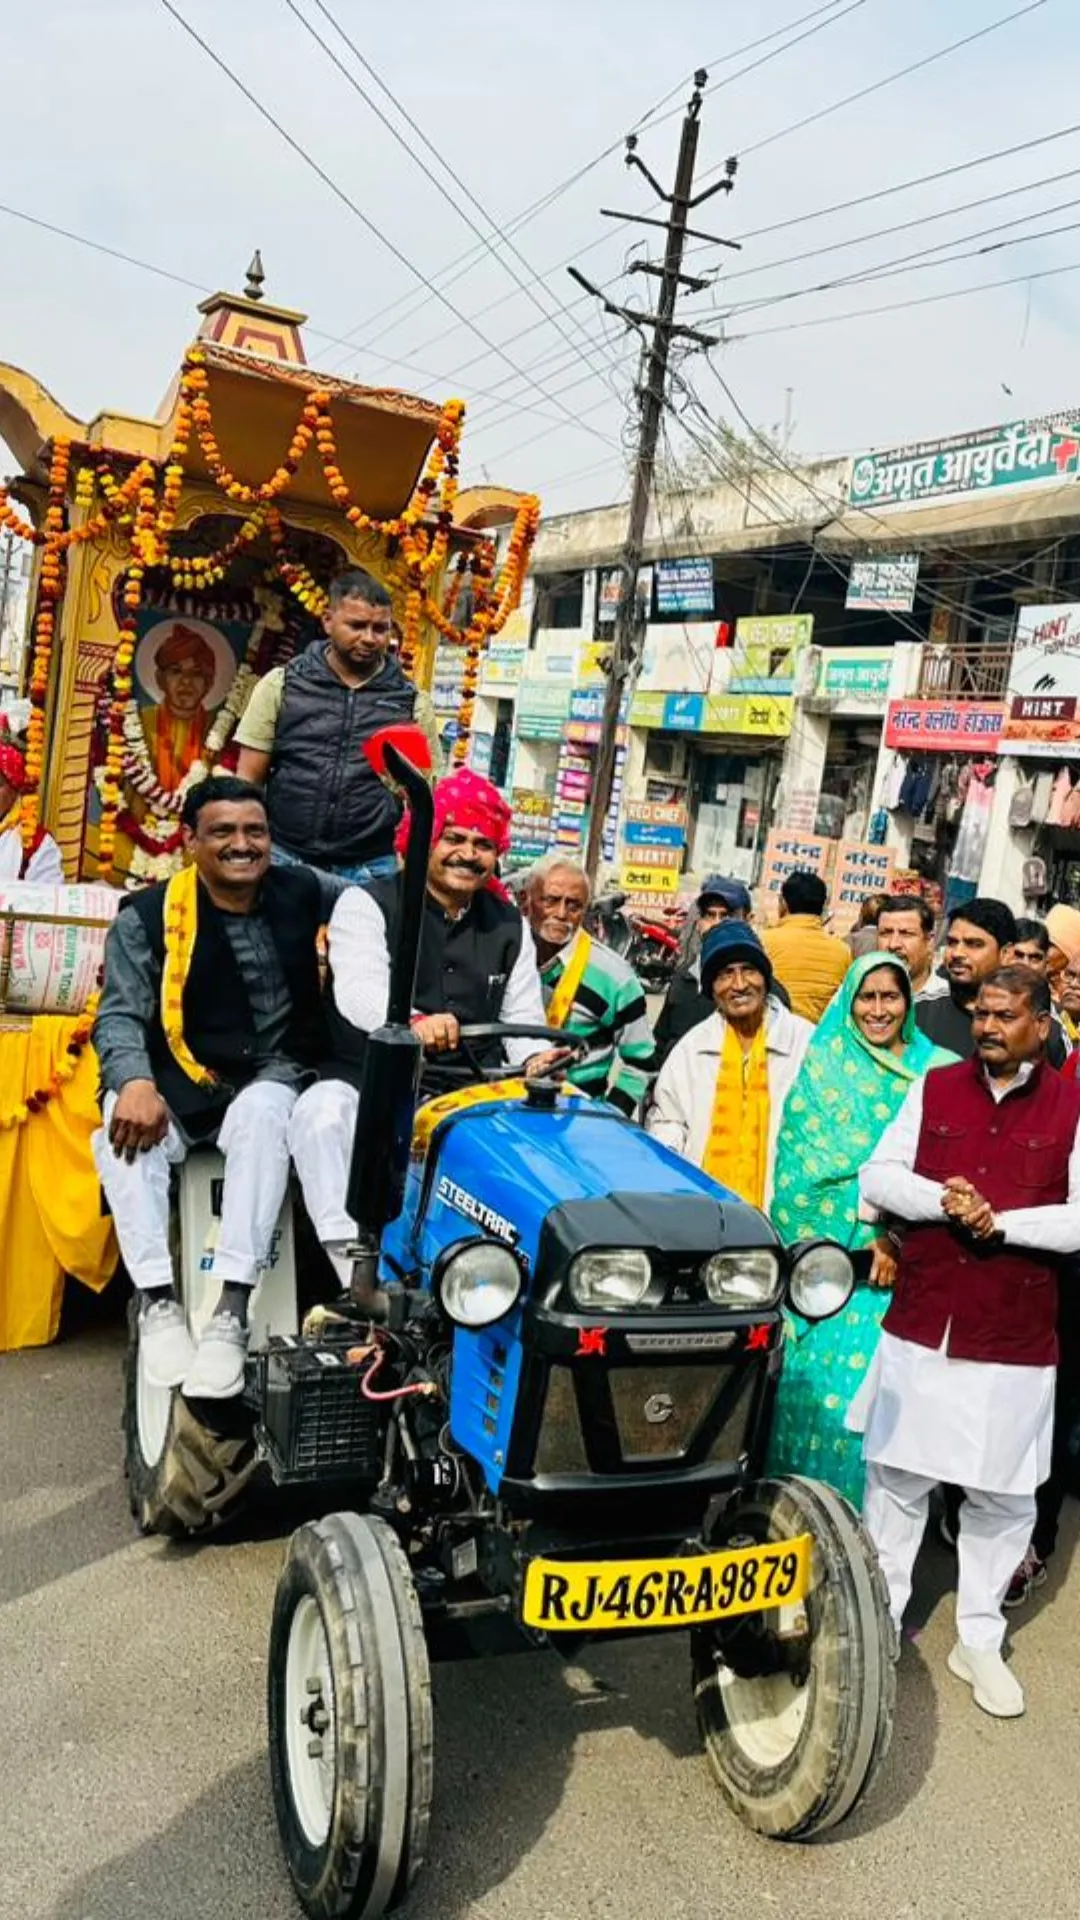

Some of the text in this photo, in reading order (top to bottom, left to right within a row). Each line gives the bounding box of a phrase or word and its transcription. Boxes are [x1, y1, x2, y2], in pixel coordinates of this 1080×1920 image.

[873, 455, 936, 500] अमृत
[438, 1175, 518, 1244] STEELTRAC
[639, 1335, 723, 1347] STEELTRAC
